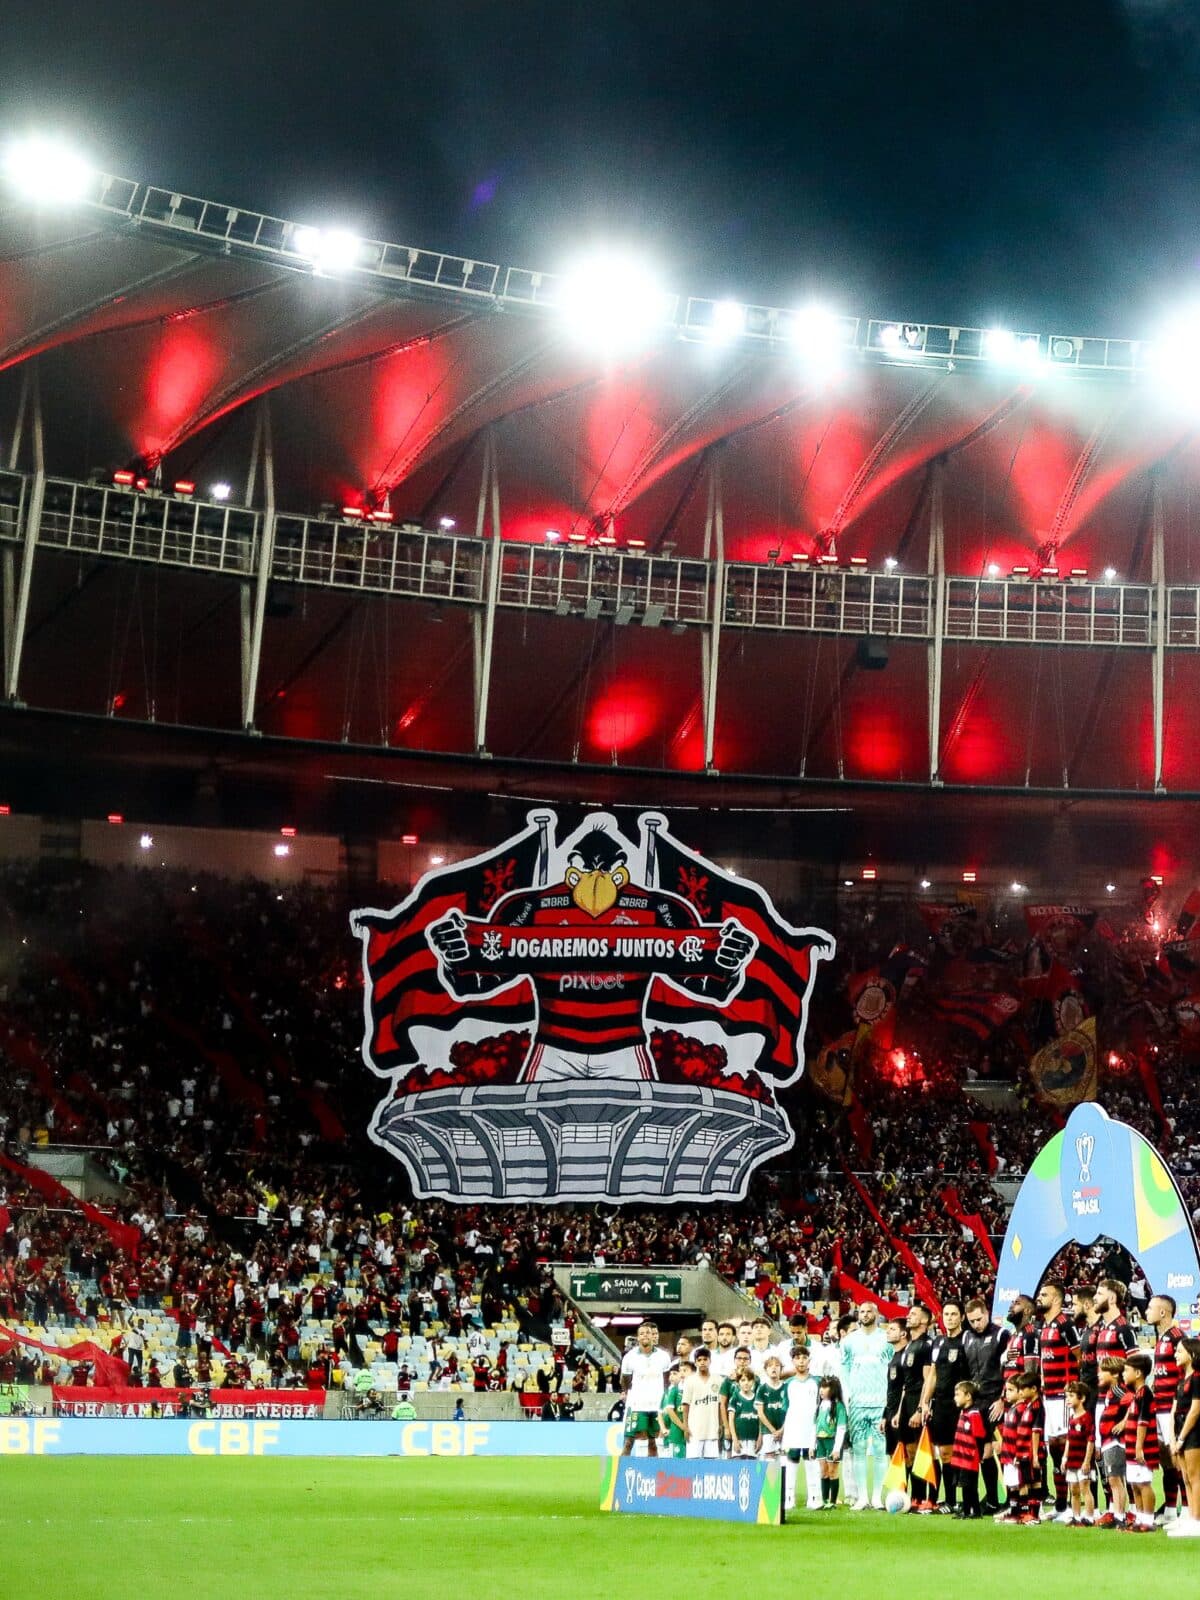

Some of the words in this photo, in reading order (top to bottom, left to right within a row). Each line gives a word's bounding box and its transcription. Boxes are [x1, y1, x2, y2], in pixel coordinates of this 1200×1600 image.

[507, 938, 608, 958] JOGAREMOS
[613, 938, 675, 959] JUNTOS
[559, 973, 625, 993] pixbet
[573, 1280, 585, 1297] T
[614, 1278, 639, 1288] SAÍDA
[656, 1282, 669, 1298] T
[0, 1420, 62, 1456] BF
[189, 1421, 281, 1456] CBF
[402, 1422, 491, 1456] CBF
[636, 1472, 656, 1501] Copa
[692, 1474, 703, 1499] do
[703, 1475, 735, 1501] BRASIL
